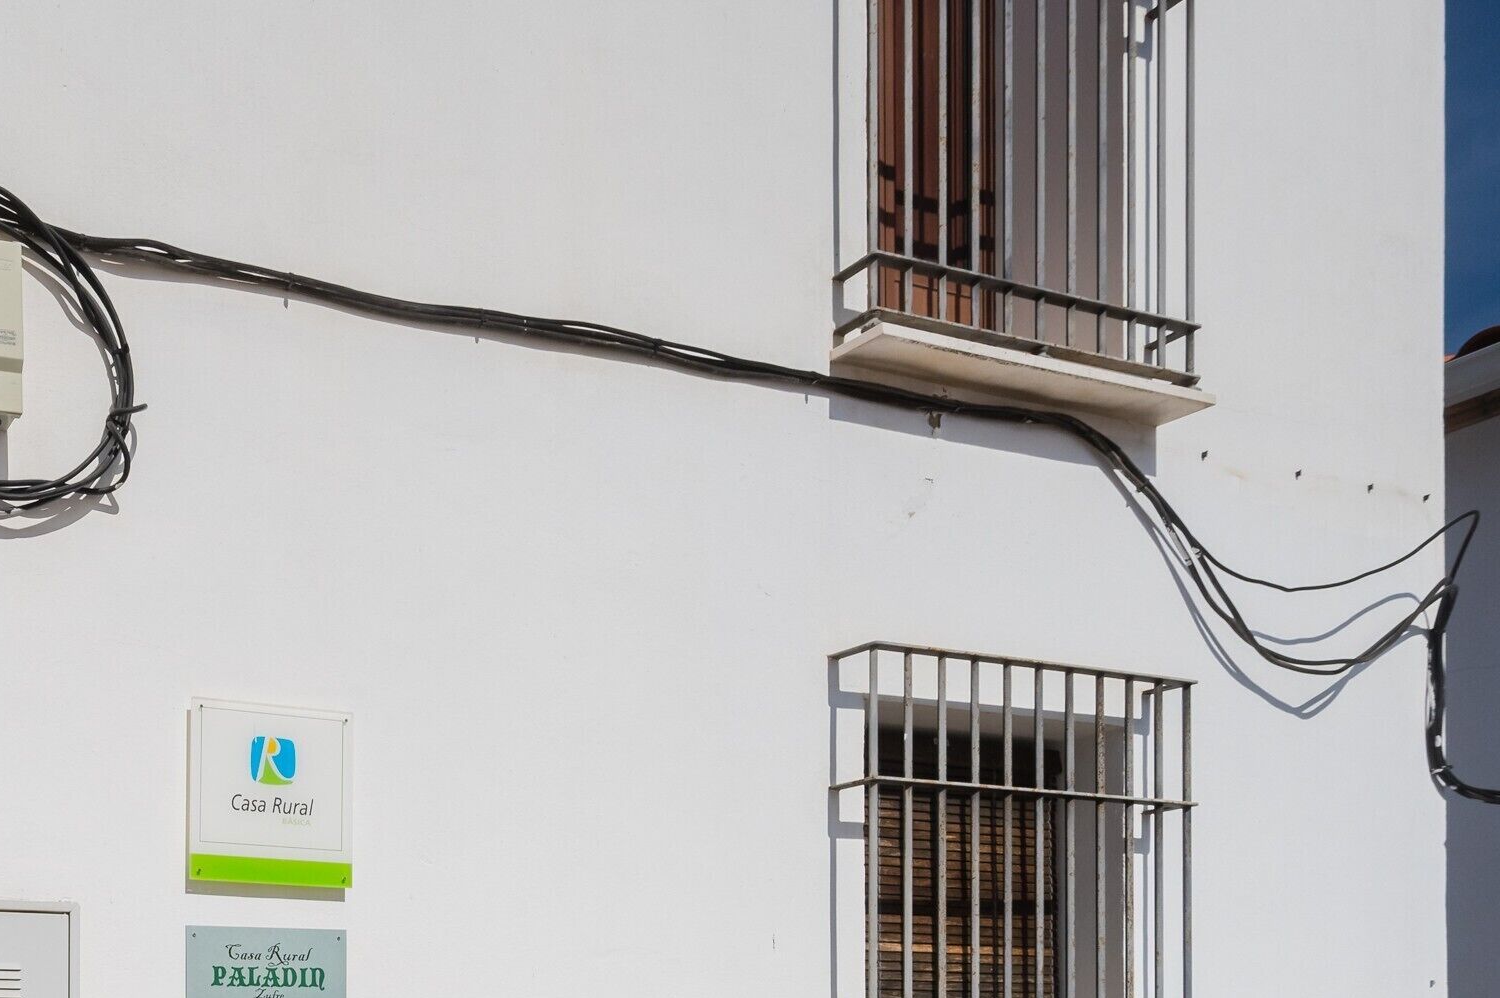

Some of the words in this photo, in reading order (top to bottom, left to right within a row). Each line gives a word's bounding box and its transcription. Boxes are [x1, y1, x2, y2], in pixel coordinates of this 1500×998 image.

[231, 794, 266, 812] Casa
[272, 797, 314, 816] Rural
[225, 943, 262, 961] Casa
[265, 943, 313, 967] Rural
